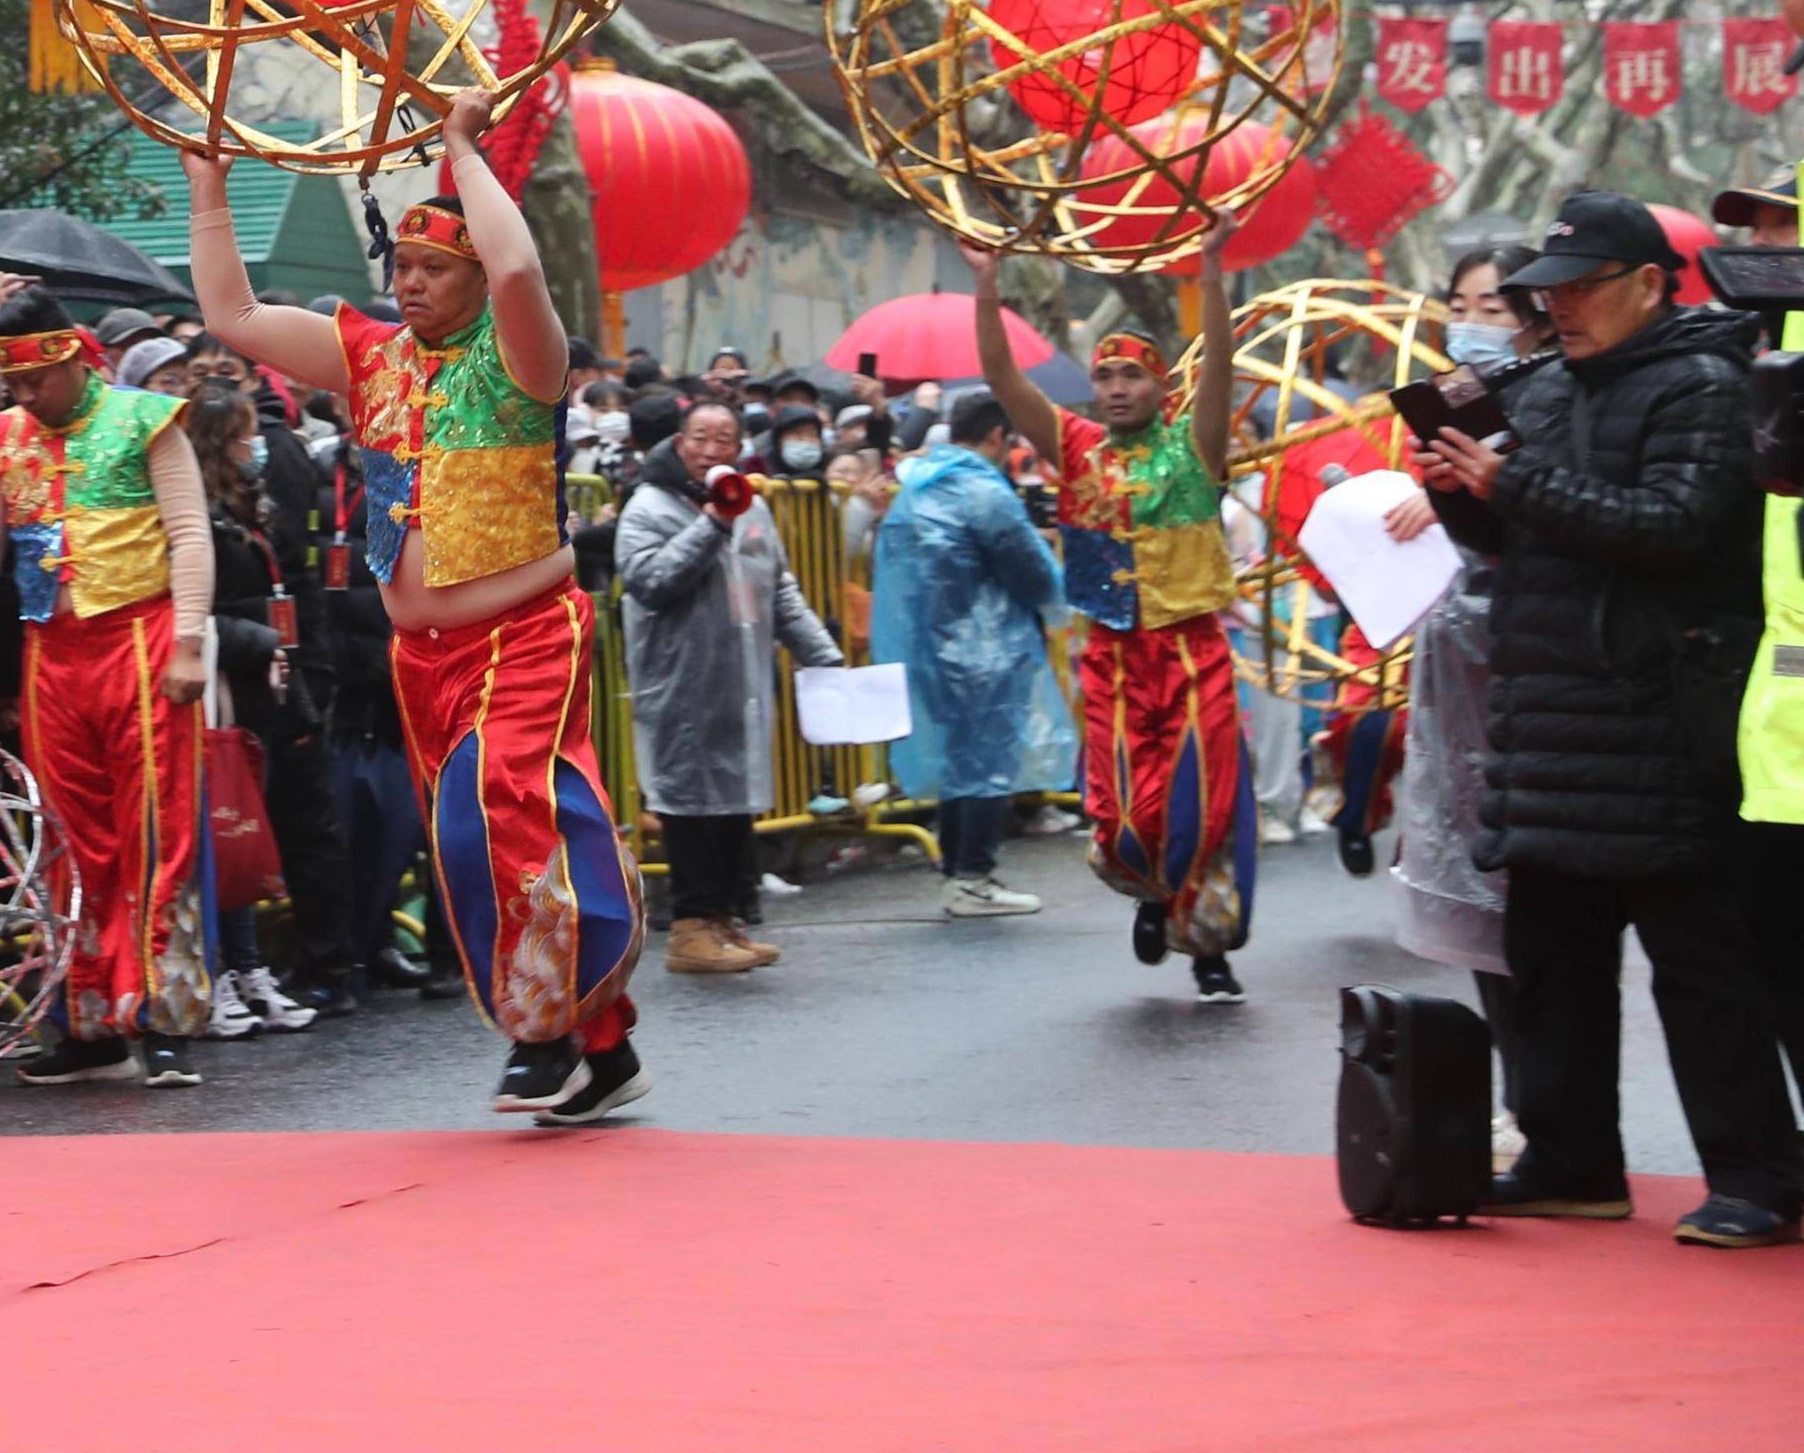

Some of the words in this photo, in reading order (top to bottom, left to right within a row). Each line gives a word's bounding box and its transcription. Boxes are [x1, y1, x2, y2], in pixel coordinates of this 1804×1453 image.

[1385, 41, 1435, 94] 发
[1500, 48, 1550, 101] 出
[1617, 50, 1670, 102] 再
[1735, 41, 1789, 96] 展
